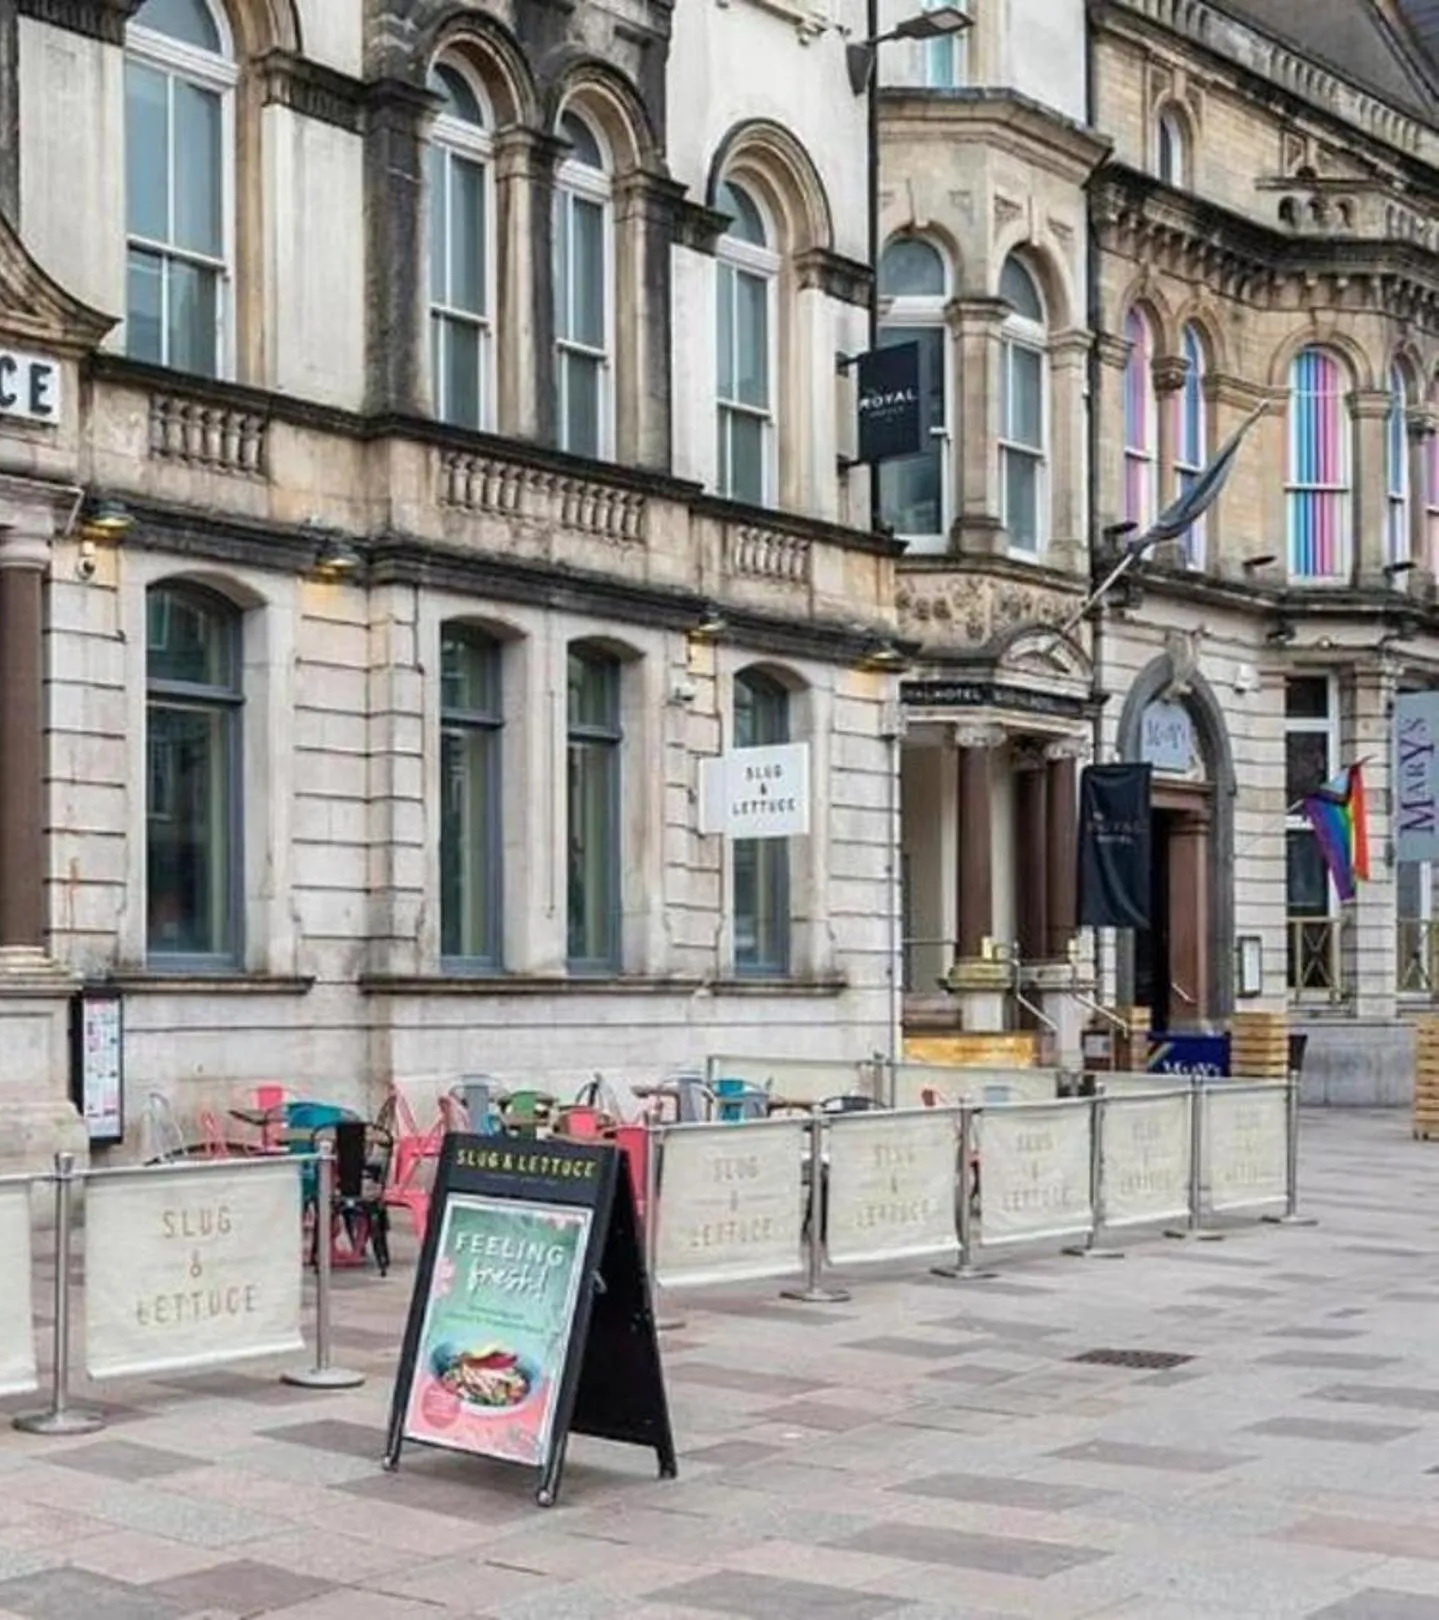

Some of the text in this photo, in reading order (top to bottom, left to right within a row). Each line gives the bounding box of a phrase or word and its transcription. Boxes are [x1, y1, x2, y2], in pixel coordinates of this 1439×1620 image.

[746, 764, 782, 781] SLUG
[732, 798, 796, 816] LETTUCE
[456, 1149, 499, 1170] SLUG
[517, 1154, 597, 1178] LETTUCE
[162, 1205, 233, 1239] SLUG
[455, 1231, 565, 1267] FEELING
[135, 1284, 257, 1326] LETTUCE
